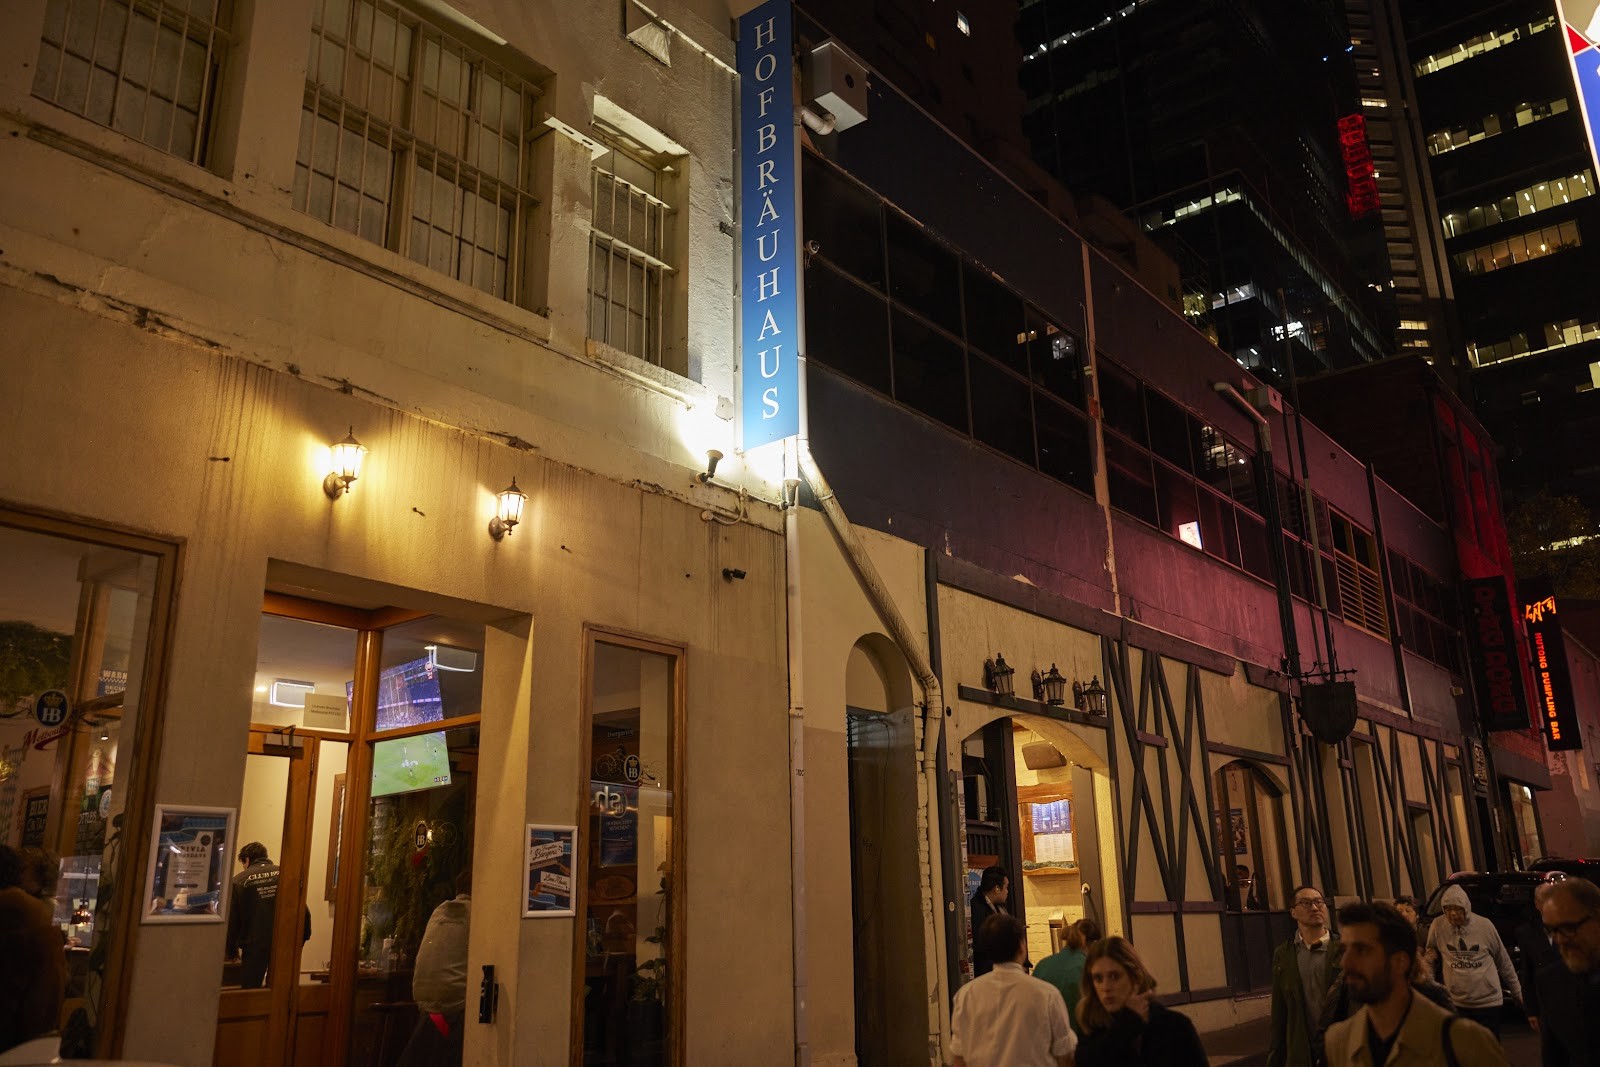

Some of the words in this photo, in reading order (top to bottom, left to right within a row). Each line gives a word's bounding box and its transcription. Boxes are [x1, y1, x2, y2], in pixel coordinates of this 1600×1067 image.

[754, 16, 783, 421] HOFBRÄUHAUS
[1534, 632, 1548, 669] HUTONG
[1541, 672, 1557, 718] DUMPLING
[1550, 721, 1561, 740] BAR
[41, 707, 62, 722] HB
[629, 767, 638, 778] HB
[30, 800, 48, 816] BIER
[248, 872, 269, 880] CLUB
[1450, 961, 1482, 969] adidas
